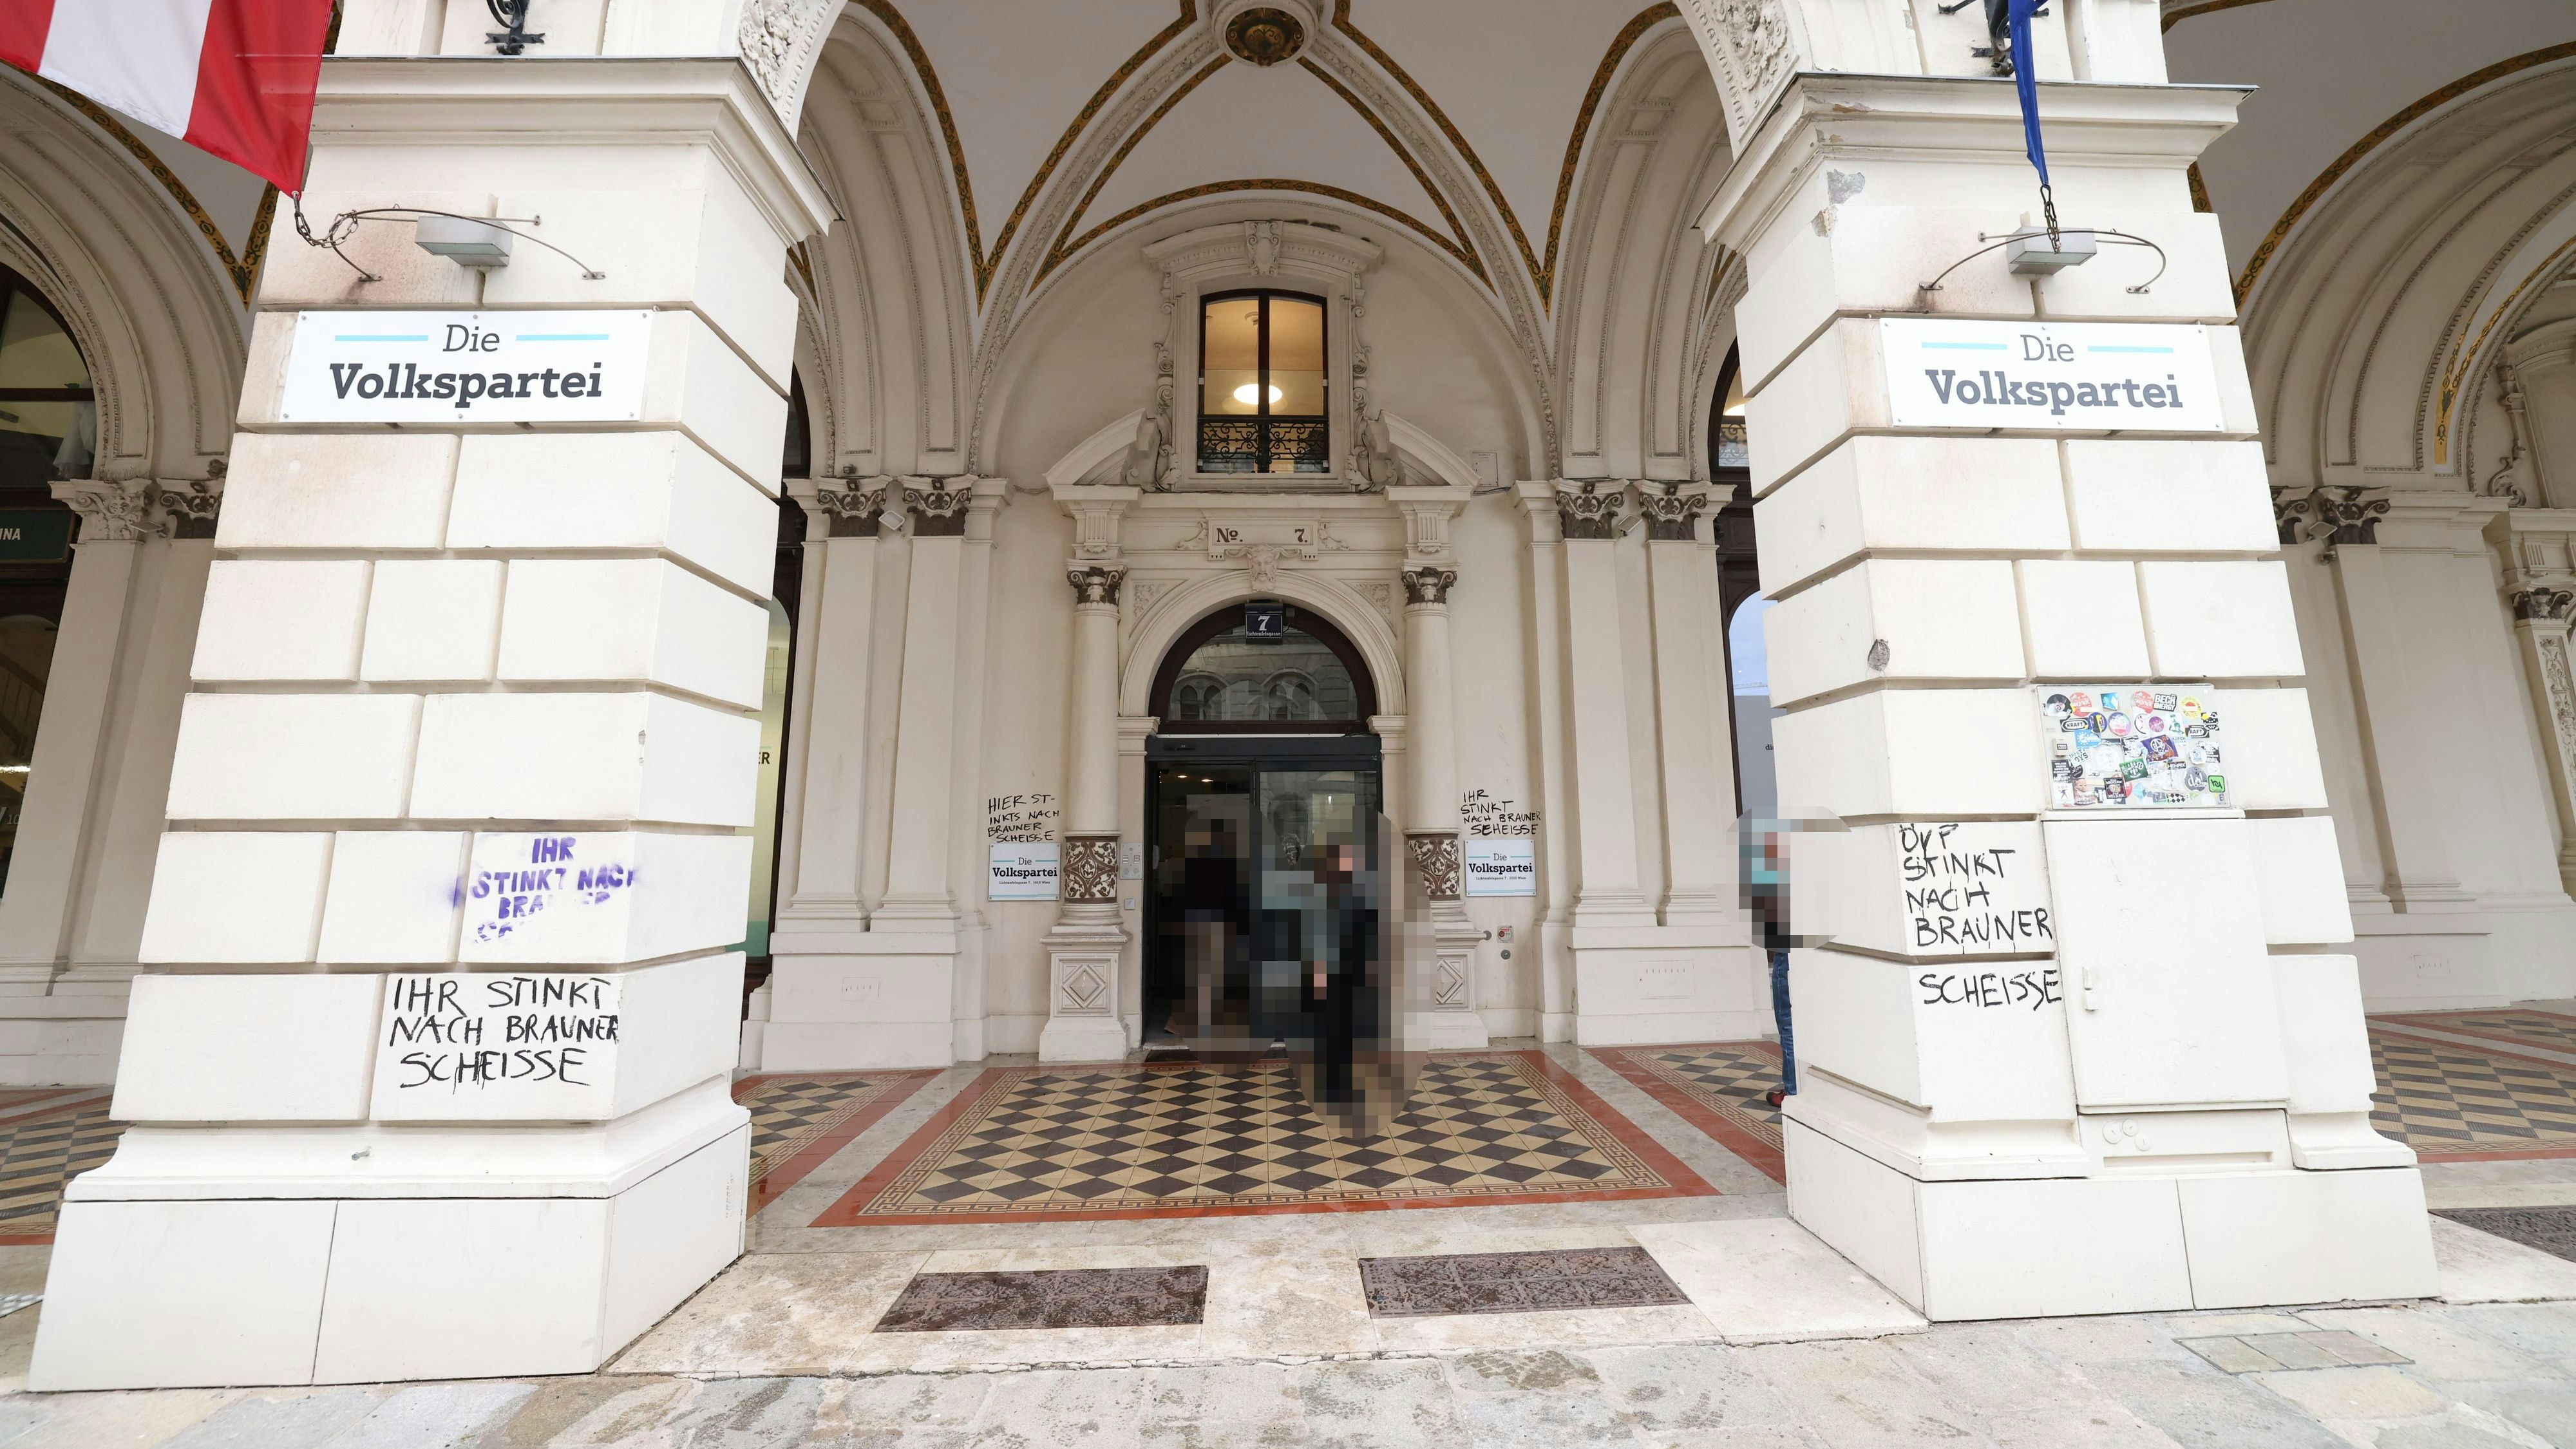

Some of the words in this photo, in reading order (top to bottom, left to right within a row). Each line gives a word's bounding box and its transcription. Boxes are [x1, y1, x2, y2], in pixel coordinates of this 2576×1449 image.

[442, 324, 500, 352] Die
[2020, 334, 2075, 362] Die
[329, 362, 602, 408] Volkspartei
[1924, 369, 2183, 415] Volkspartei
[1258, 615, 1270, 630] 7
[759, 752, 770, 764] R
[989, 795, 1027, 815] HIER
[1463, 789, 1489, 802] IHR
[1461, 800, 1514, 814] STINKT
[990, 812, 1021, 825] INKTS
[1028, 810, 1059, 820] NACH
[1464, 815, 1492, 824] NACH
[1499, 811, 1541, 822] BRAUNER
[987, 822, 1042, 837] BRAUNER
[996, 830, 1056, 843] SCHEISSE
[532, 836, 576, 864] IHR
[1493, 853, 1508, 861] Die
[1018, 857, 1033, 865] Die
[1468, 862, 1533, 875] Volkspartei
[1903, 849, 2016, 882] STINKT
[992, 867, 1058, 880] Volkspartei
[1905, 881, 1990, 913] NACH
[1915, 907, 2052, 947] BRAUNER
[393, 977, 467, 1017] IHR
[487, 976, 611, 1010] STINKT
[1918, 969, 2062, 1011] SCHEISSE
[389, 1014, 483, 1046] NACH
[506, 1013, 620, 1045] BRAUNER
[400, 1047, 592, 1091] SCHEISSE
